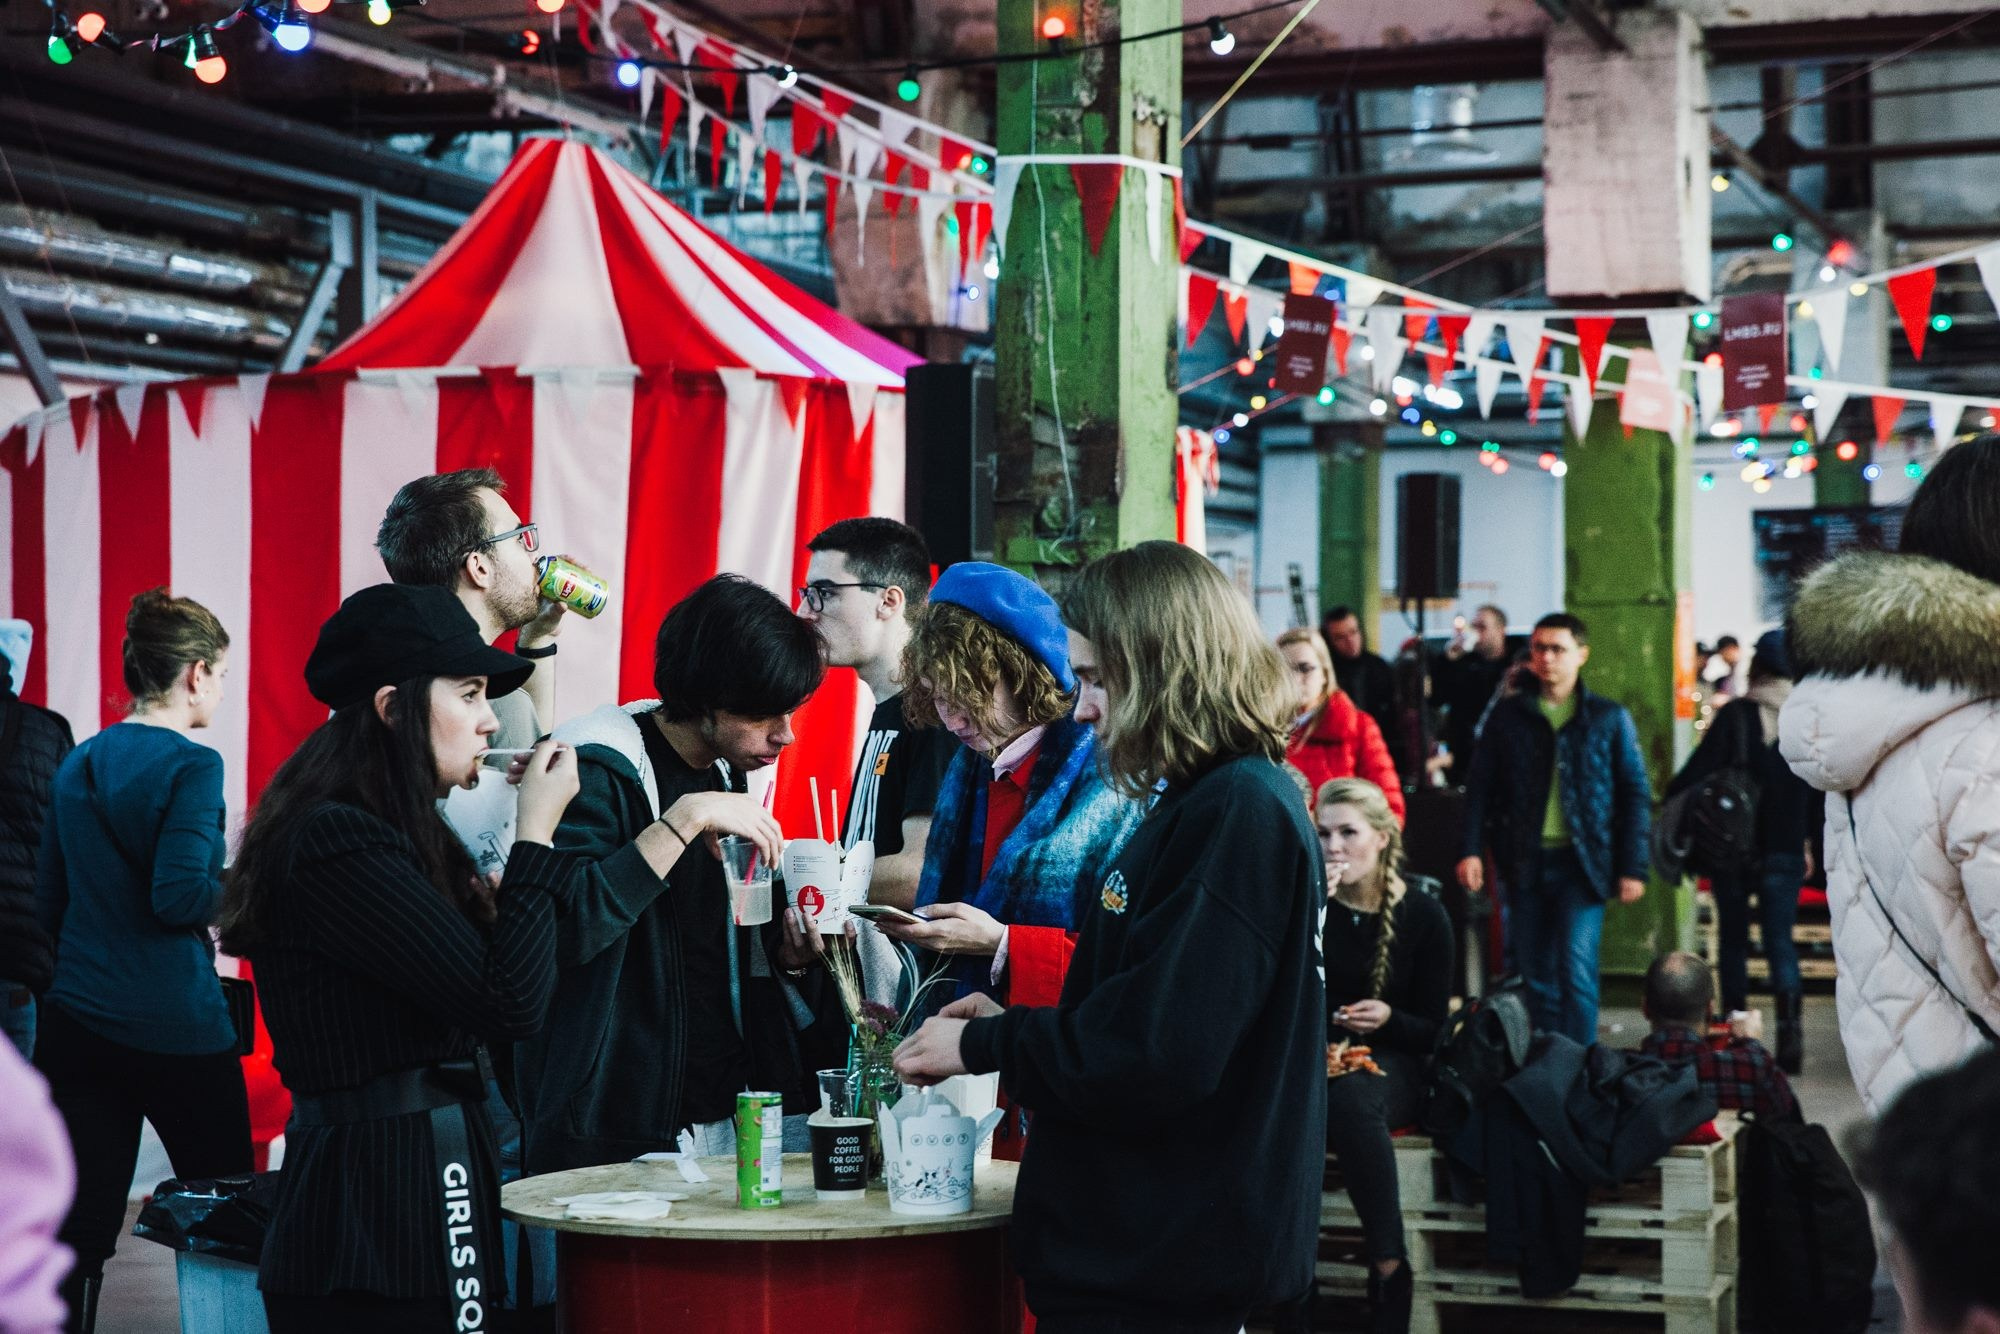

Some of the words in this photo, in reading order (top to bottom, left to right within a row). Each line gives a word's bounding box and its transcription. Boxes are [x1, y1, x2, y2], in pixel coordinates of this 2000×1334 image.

[836, 1136, 859, 1145] GOOD
[834, 1145, 861, 1154] COFFEE
[829, 1156, 844, 1164] FOR
[845, 1155, 865, 1163] GOOD
[834, 1165, 860, 1173] PEOPLE
[443, 1162, 476, 1268] GIRLS
[456, 1277, 485, 1334] SQ
